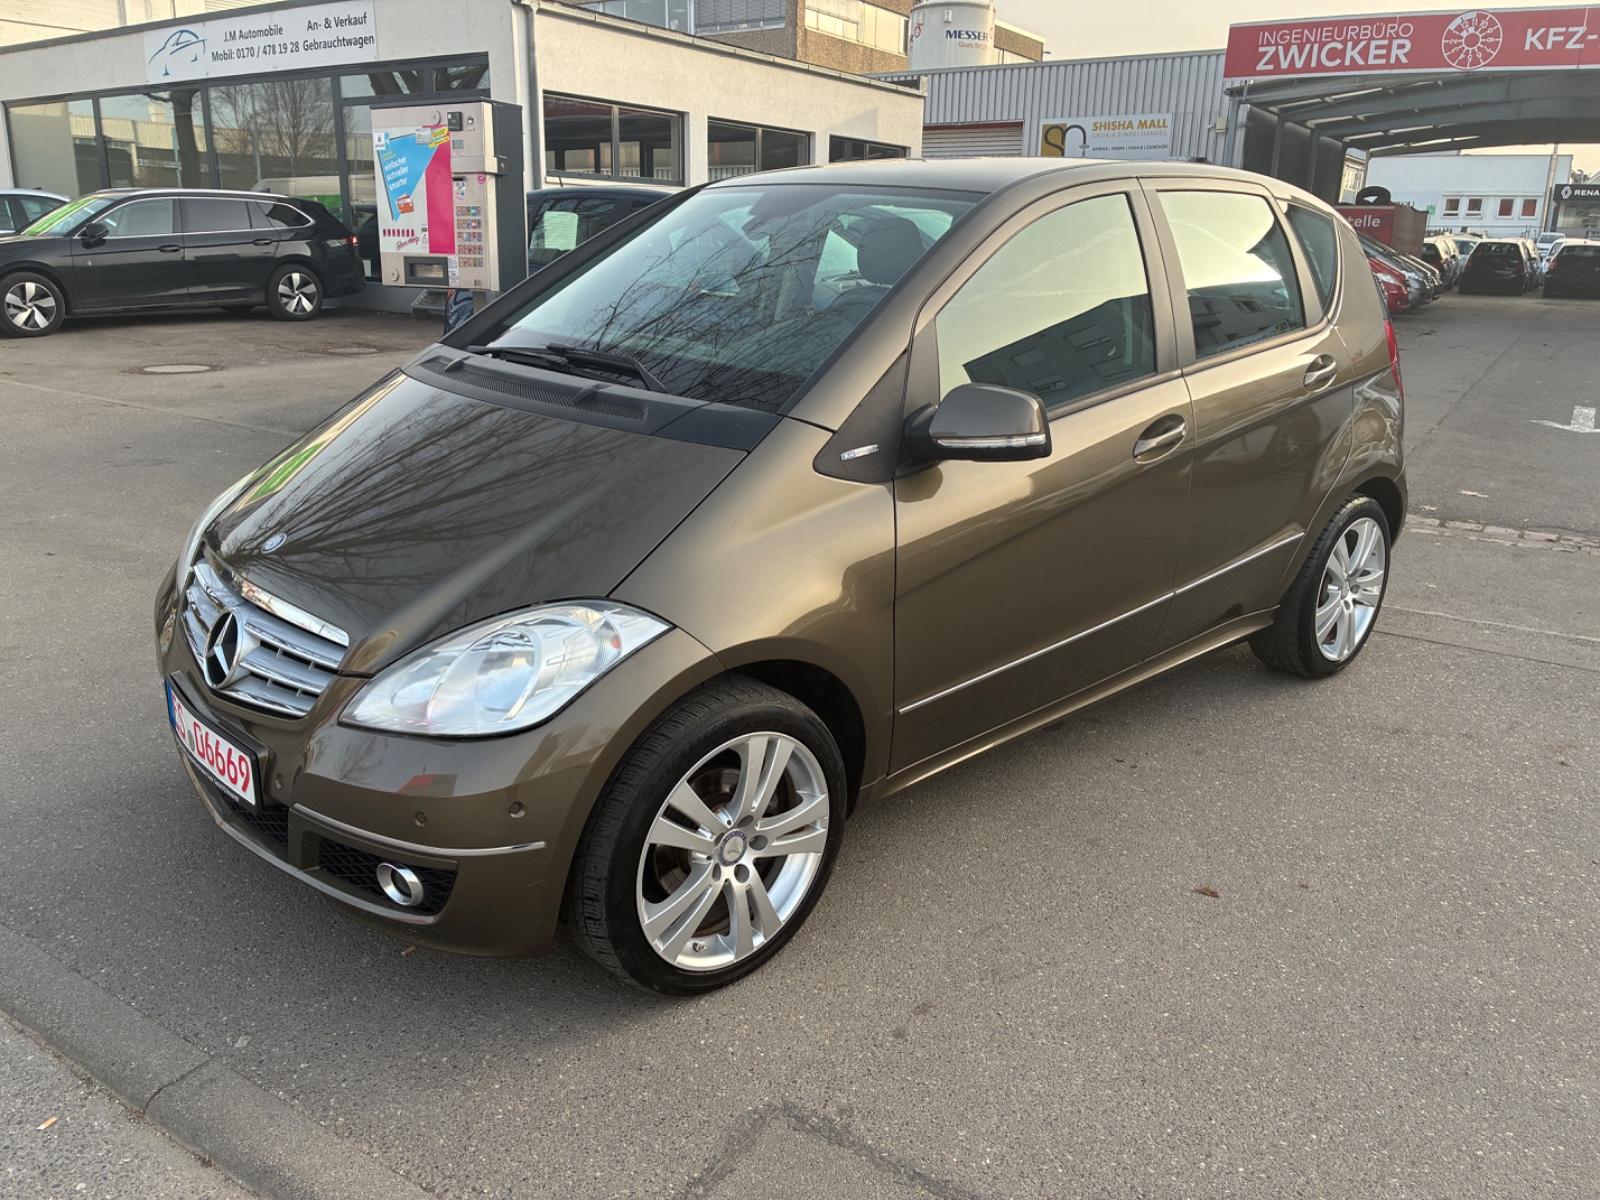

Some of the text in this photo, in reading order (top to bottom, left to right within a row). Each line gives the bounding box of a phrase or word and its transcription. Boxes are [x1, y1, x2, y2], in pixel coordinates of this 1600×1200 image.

[306, 12, 367, 31] An- & Verkauf
[224, 24, 284, 42] J.M Automobile
[302, 35, 375, 51] Gebrauchtwagen
[945, 29, 989, 41] MESSER
[1258, 22, 1414, 45] INGENIEURBÜRO
[1524, 26, 1598, 51] KFZ-
[211, 41, 300, 62] Mobil: 0170 / 478 19 28
[1255, 38, 1412, 71] ZWICKER
[1092, 118, 1168, 132] SHISHA MALL
[193, 720, 250, 793] 06669
